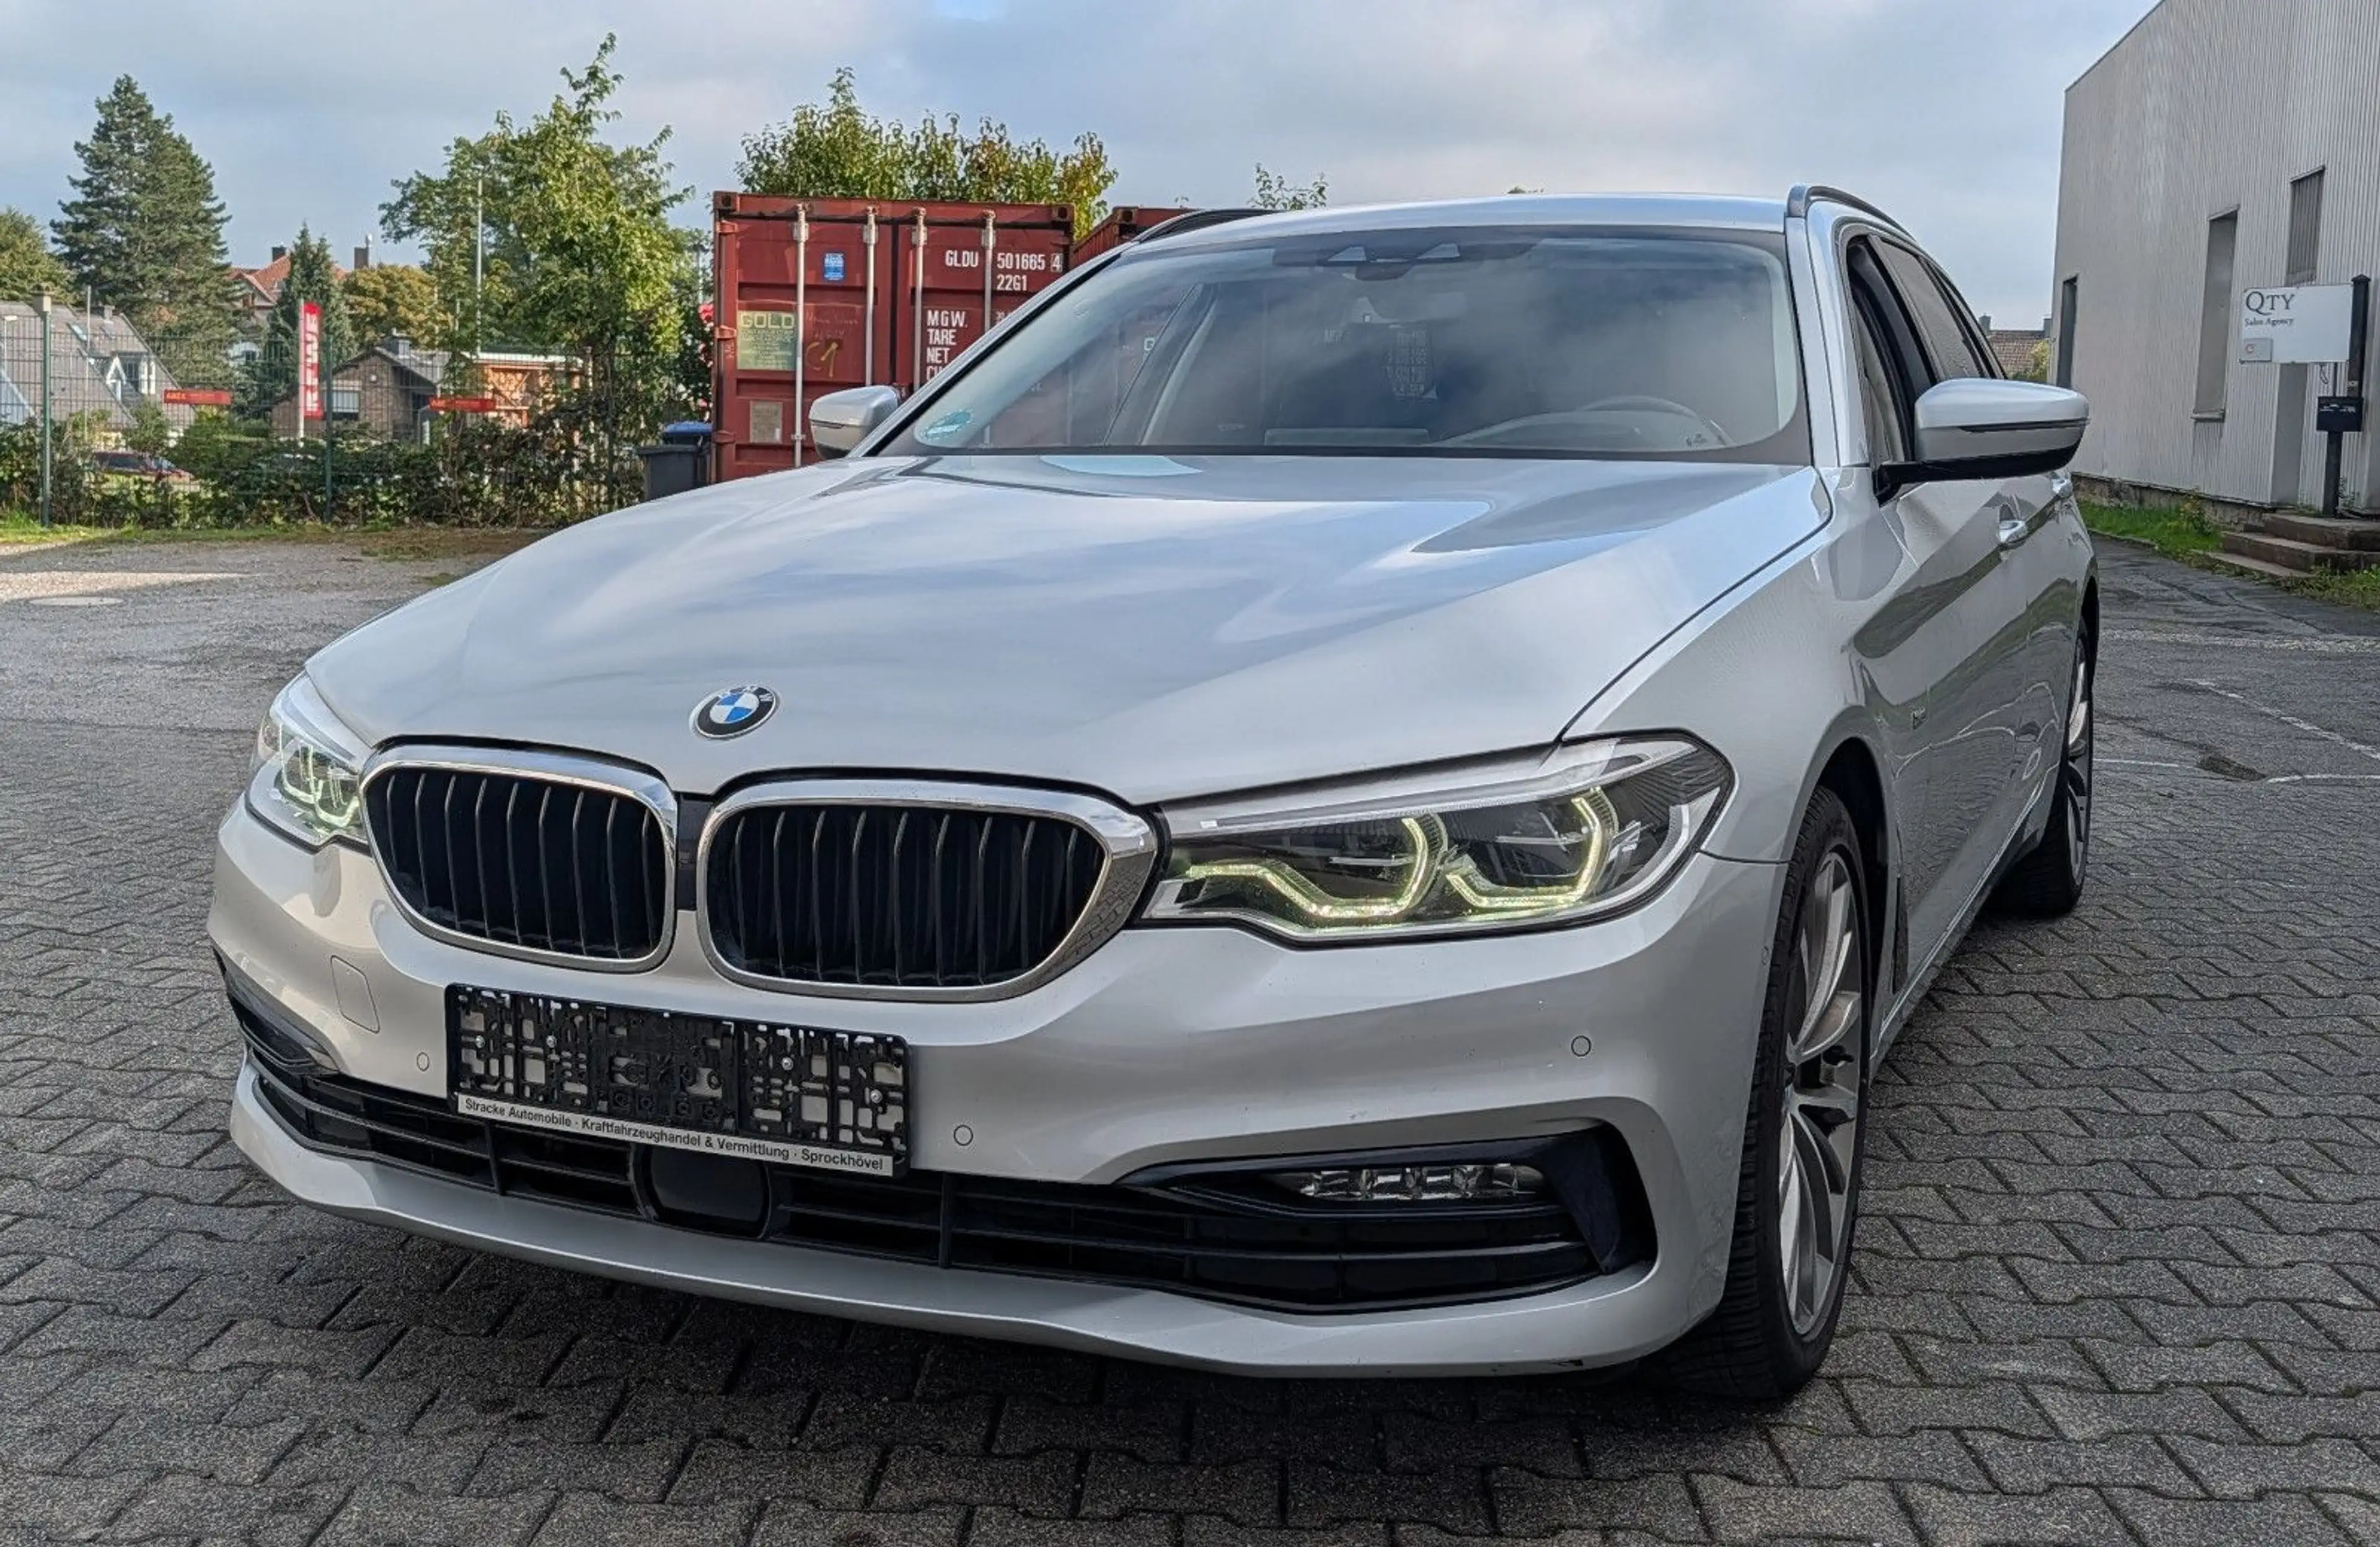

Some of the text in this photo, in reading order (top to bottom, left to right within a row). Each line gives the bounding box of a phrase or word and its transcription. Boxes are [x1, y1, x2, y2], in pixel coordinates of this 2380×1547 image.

[945, 250, 979, 267] GLDU
[997, 252, 1046, 270] 501665
[997, 275, 1027, 291] 22G1
[2246, 291, 2294, 315] QTY
[741, 312, 795, 328] GOLD
[927, 328, 957, 346] TARE
[927, 347, 950, 364] NET
[465, 1098, 883, 1170] Stracke Automobile Kraftfahrzeughandel & Vermittlung Sprockhövel
